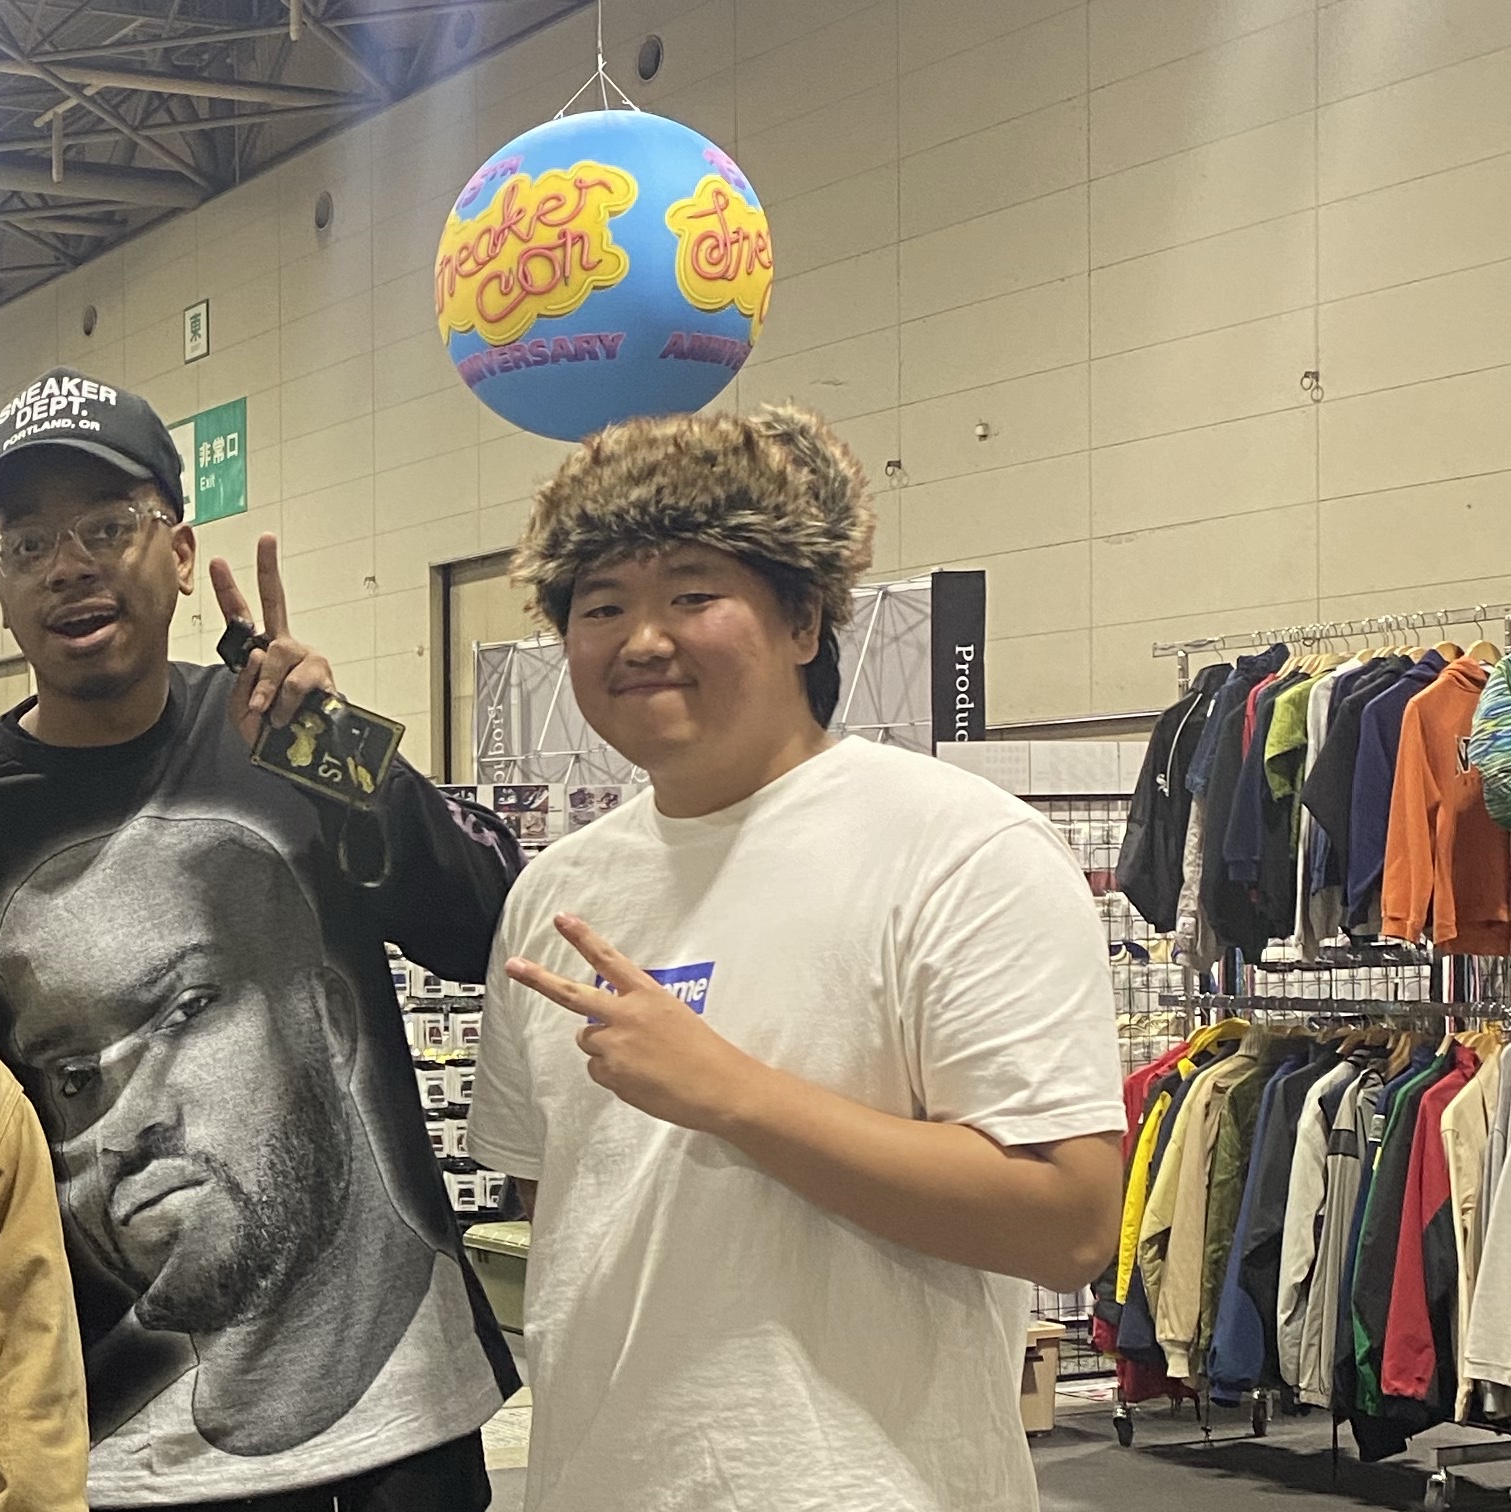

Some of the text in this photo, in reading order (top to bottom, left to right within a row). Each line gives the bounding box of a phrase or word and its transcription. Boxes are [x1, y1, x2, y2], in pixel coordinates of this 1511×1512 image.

[15, 395, 88, 429] DEPT.
[2, 418, 100, 451] PORTLAND, OR
[199, 432, 239, 468] 非常口
[200, 475, 215, 491] Exit
[955, 644, 975, 742] Produc
